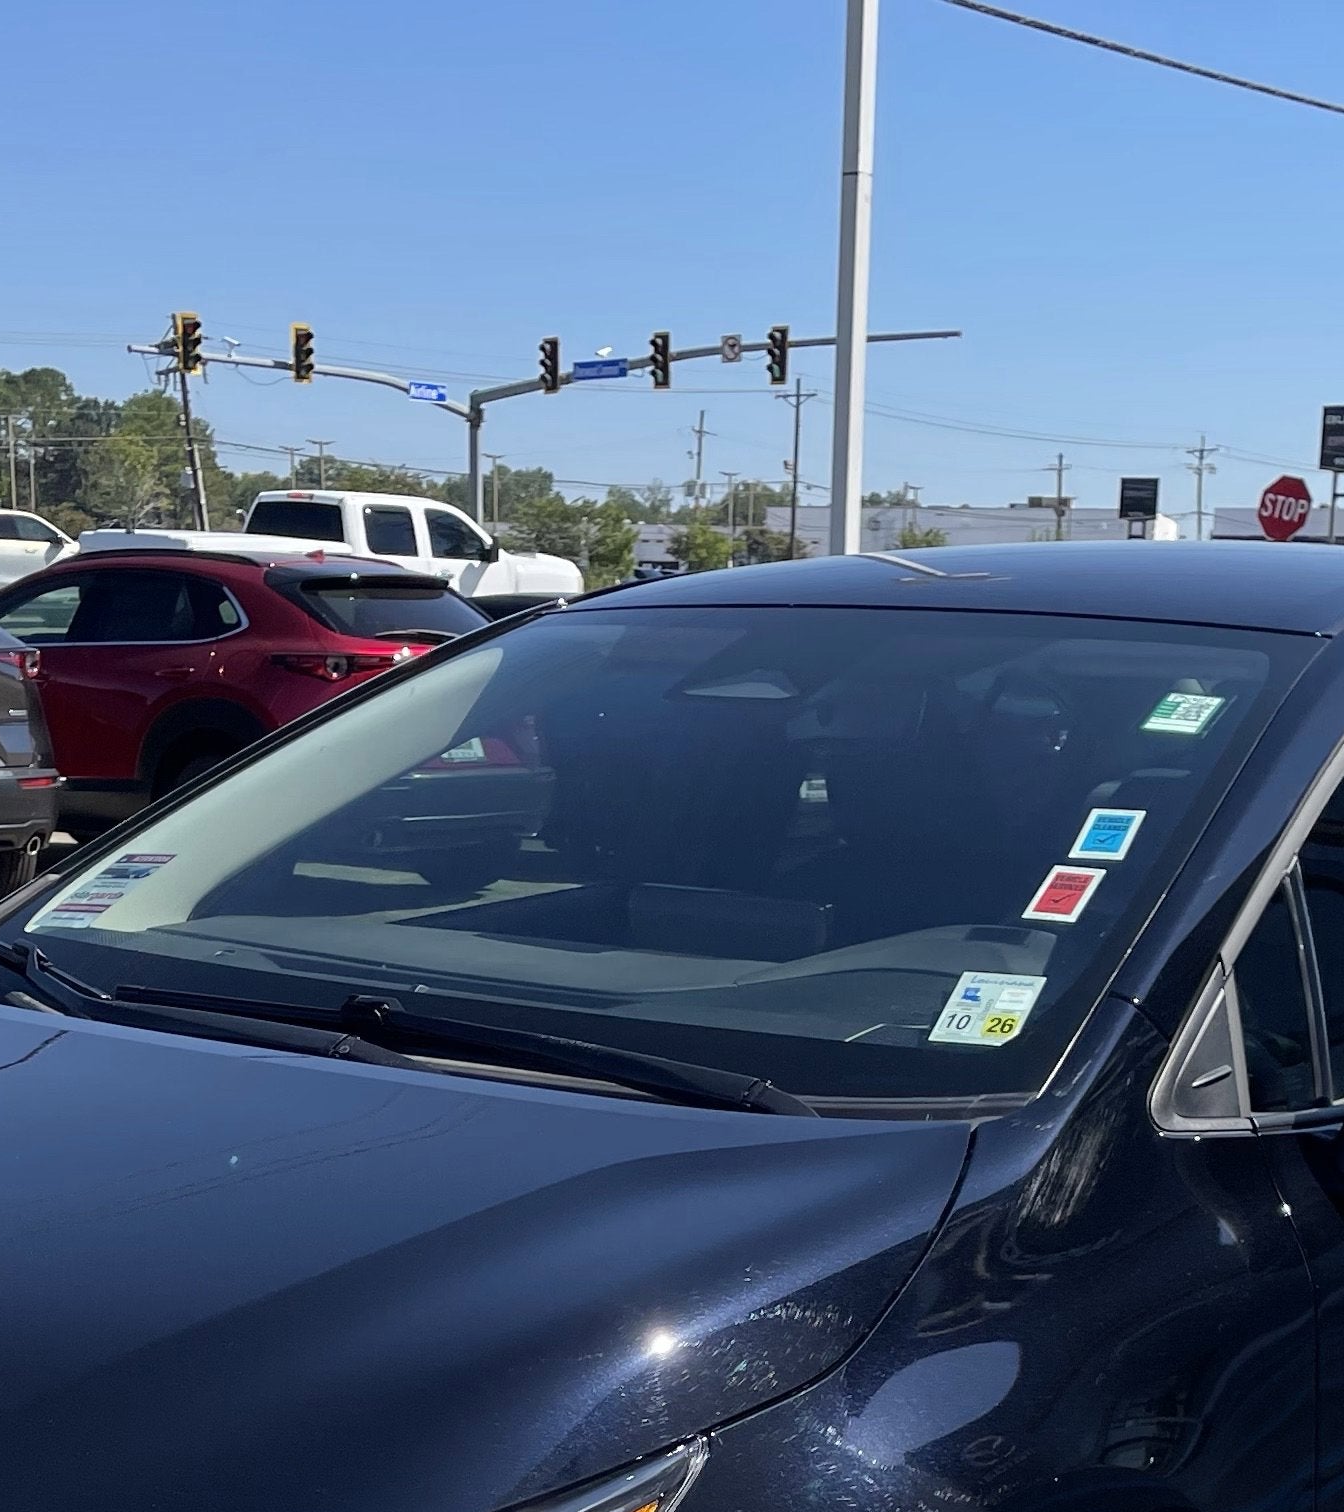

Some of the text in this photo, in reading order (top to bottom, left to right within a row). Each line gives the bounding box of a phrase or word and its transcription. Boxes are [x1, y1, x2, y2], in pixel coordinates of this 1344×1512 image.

[1261, 493, 1309, 522] STOP
[946, 1013, 972, 1030] 10
[986, 1017, 1016, 1034] 26
